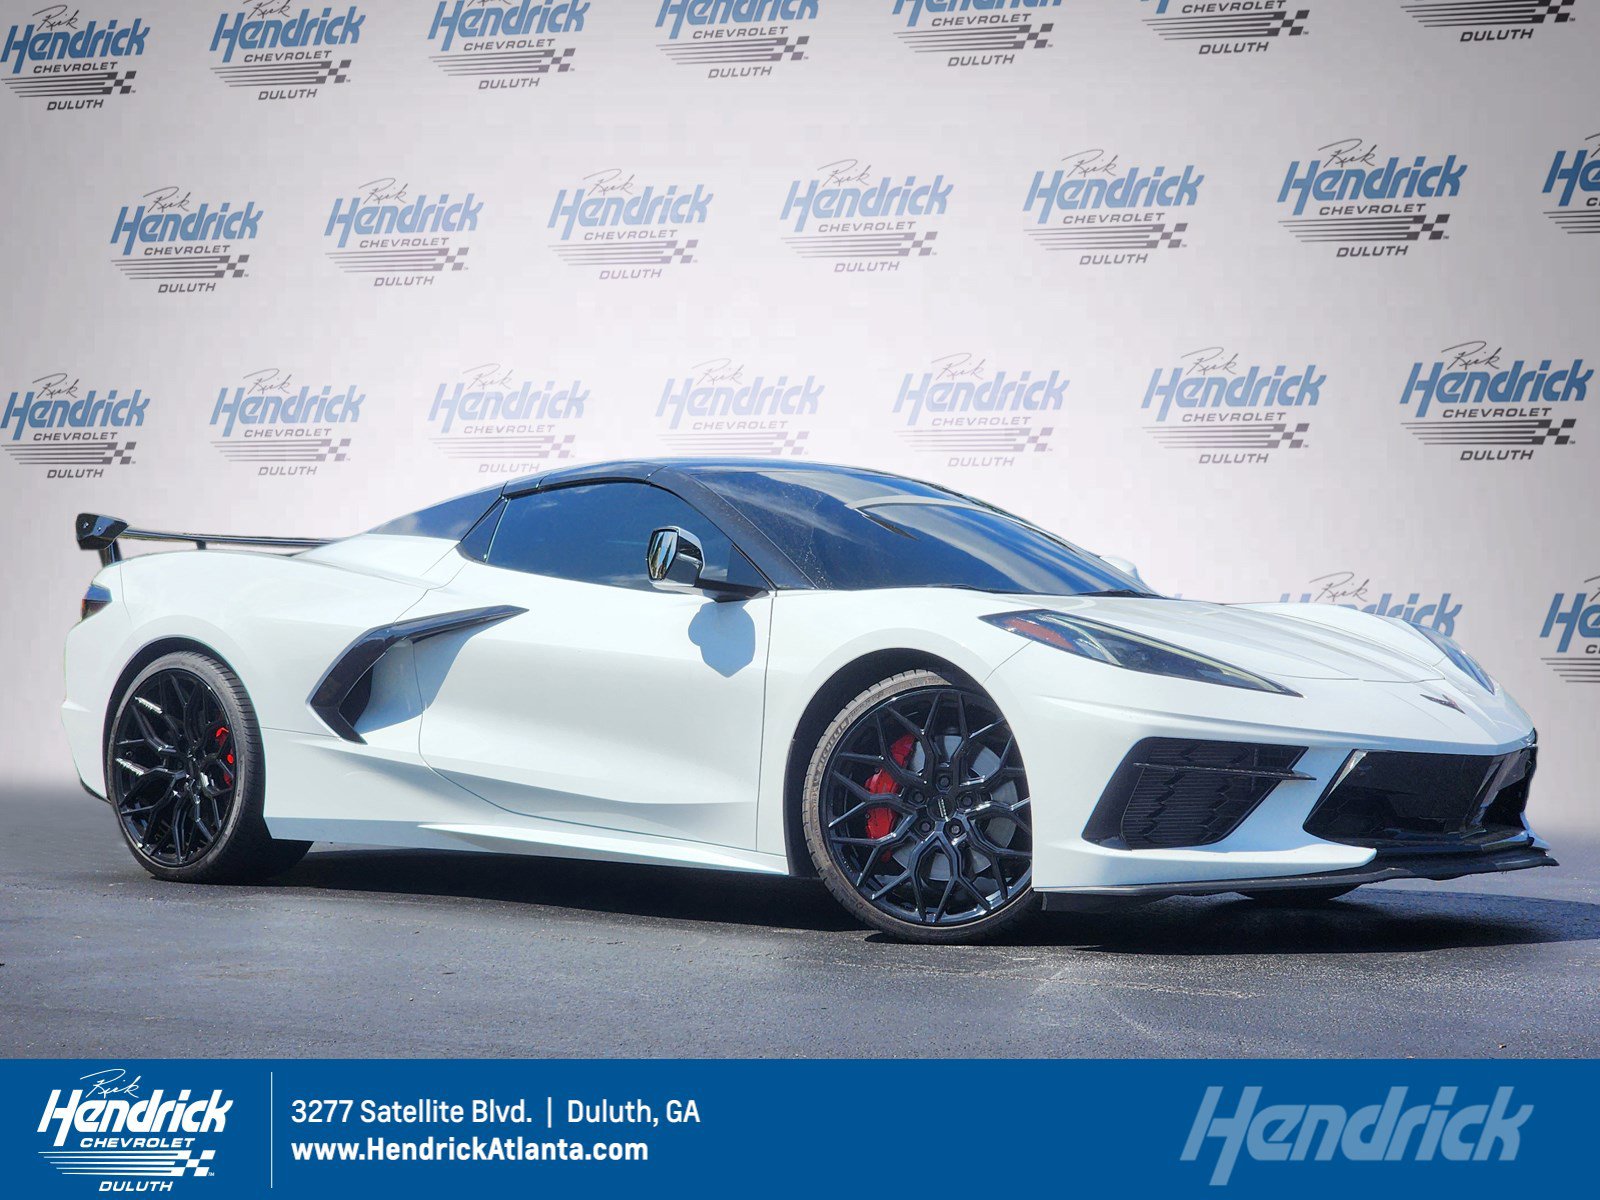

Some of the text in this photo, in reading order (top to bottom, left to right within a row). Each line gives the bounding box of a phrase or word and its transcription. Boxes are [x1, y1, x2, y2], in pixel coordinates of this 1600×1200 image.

[1181, 0, 1286, 14] CHEVROLET
[427, 0, 591, 52] Hendrick
[931, 13, 1032, 27] CHEVROLET
[209, 6, 366, 63] Hendrick
[692, 26, 789, 40] CHEVROLET
[1459, 28, 1534, 42] DULUTH
[0, 18, 150, 74] Hendrick
[463, 38, 556, 51] CHEVROLET
[1198, 41, 1270, 55] DULUTH
[243, 50, 332, 63] CHEVROLET
[947, 54, 1015, 67] DULUTH
[33, 61, 118, 74] CHEVROLET
[707, 66, 773, 79] DULUTH
[478, 77, 540, 90] DULUTH
[258, 89, 318, 101] DULUTH
[47, 99, 104, 111] DULUTH
[1277, 155, 1468, 216] Hendrick
[1022, 165, 1205, 224] Hendrick
[779, 175, 954, 233] Hendrick
[1319, 203, 1427, 216] CHEVROLET
[547, 184, 714, 241] Hendrick
[1063, 212, 1165, 224] CHEVROLET
[324, 193, 484, 248] Hendrick
[818, 221, 916, 233] CHEVROLET
[110, 201, 264, 256] Hendrick
[584, 229, 678, 241] CHEVROLET
[359, 237, 450, 248] CHEVROLET
[143, 244, 230, 256] CHEVROLET
[1336, 245, 1409, 258] DULUTH
[1079, 253, 1148, 265] DULUTH
[834, 261, 900, 273] DULUTH
[599, 268, 663, 280] DULUTH
[157, 282, 217, 293] DULUTH
[373, 276, 435, 287] DULUTH
[1141, 364, 1327, 422] Hendrick
[1399, 359, 1595, 418] Hendrick
[655, 375, 826, 430] Hendrick
[892, 370, 1071, 426] Hendrick
[209, 385, 366, 437] Hendrick
[427, 380, 591, 434] Hendrick
[1442, 407, 1552, 418] CHEVROLET
[0, 389, 150, 441] Hendrick
[931, 416, 1032, 426] CHEVROLET
[1181, 412, 1286, 423] CHEVROLET
[463, 424, 556, 434] CHEVROLET
[692, 420, 789, 430] CHEVROLET
[33, 431, 118, 442] CHEVROLET
[243, 428, 332, 438] CHEVROLET
[1198, 453, 1269, 464] DULUTH
[1459, 449, 1534, 461] DULUTH
[478, 463, 540, 473] DULUTH
[947, 457, 1015, 467] DULUTH
[47, 469, 104, 479] DULUTH
[257, 466, 318, 476] DULUTH
